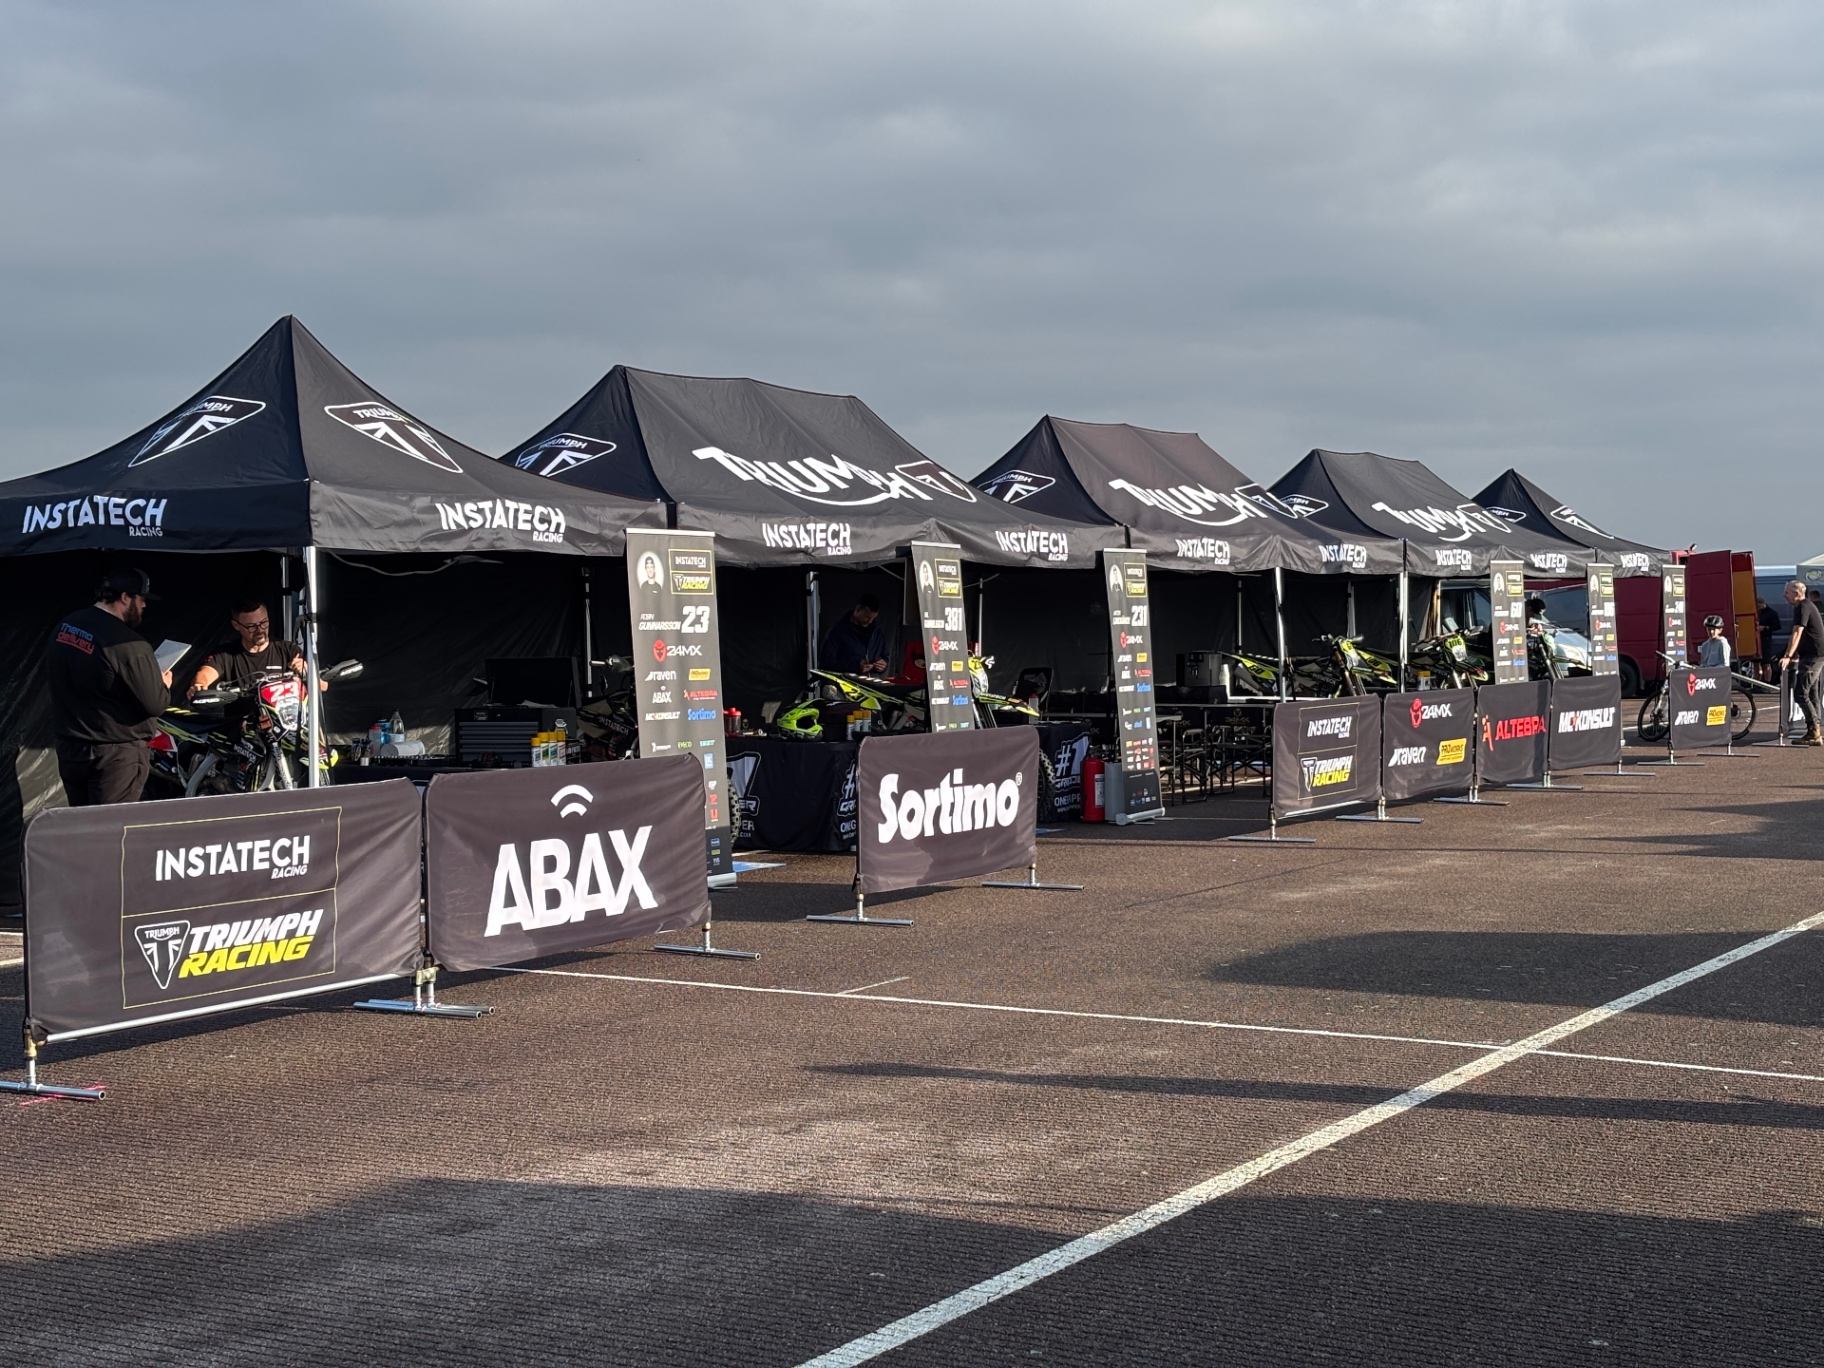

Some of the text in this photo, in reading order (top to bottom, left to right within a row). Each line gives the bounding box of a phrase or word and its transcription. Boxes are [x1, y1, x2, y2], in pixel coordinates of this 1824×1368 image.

[692, 446, 933, 506] TRIUMPH
[1108, 478, 1268, 527] TRIUMPH
[22, 495, 167, 533] INSTATECH
[435, 498, 566, 533] INSTATECH
[129, 526, 163, 537] RACING
[532, 530, 564, 543] RACING
[762, 522, 850, 548] INSTATECH
[995, 530, 1069, 553] INSTATECH
[827, 546, 852, 555] RACING
[1175, 537, 1231, 558] INSTATECH
[1319, 543, 1367, 562] INSTATECH
[681, 605, 711, 634] 23
[944, 607, 963, 632] 381
[1131, 605, 1148, 627] 231
[60, 622, 94, 642] Thermo
[666, 645, 703, 656] 24MX
[938, 641, 959, 651] 24MX
[651, 671, 677, 681] raven
[1694, 678, 1717, 690] 24MX
[269, 681, 300, 703] 23
[652, 691, 673, 703] ABAX
[687, 708, 717, 721] Sortimo
[1421, 703, 1453, 720] 24MX
[1307, 716, 1353, 738] INSTATECH
[1494, 714, 1547, 740] ALTEBRA
[1313, 755, 1354, 773] TRIUMPH
[1395, 746, 1427, 766] raven
[1312, 770, 1350, 788] RACING
[155, 835, 311, 881] INSTATECH
[271, 864, 309, 880] RACING
[484, 825, 659, 937] ABAX
[144, 926, 180, 941] TRIUMPH
[187, 908, 324, 955] TRIUMPH
[178, 935, 315, 979] RACING
